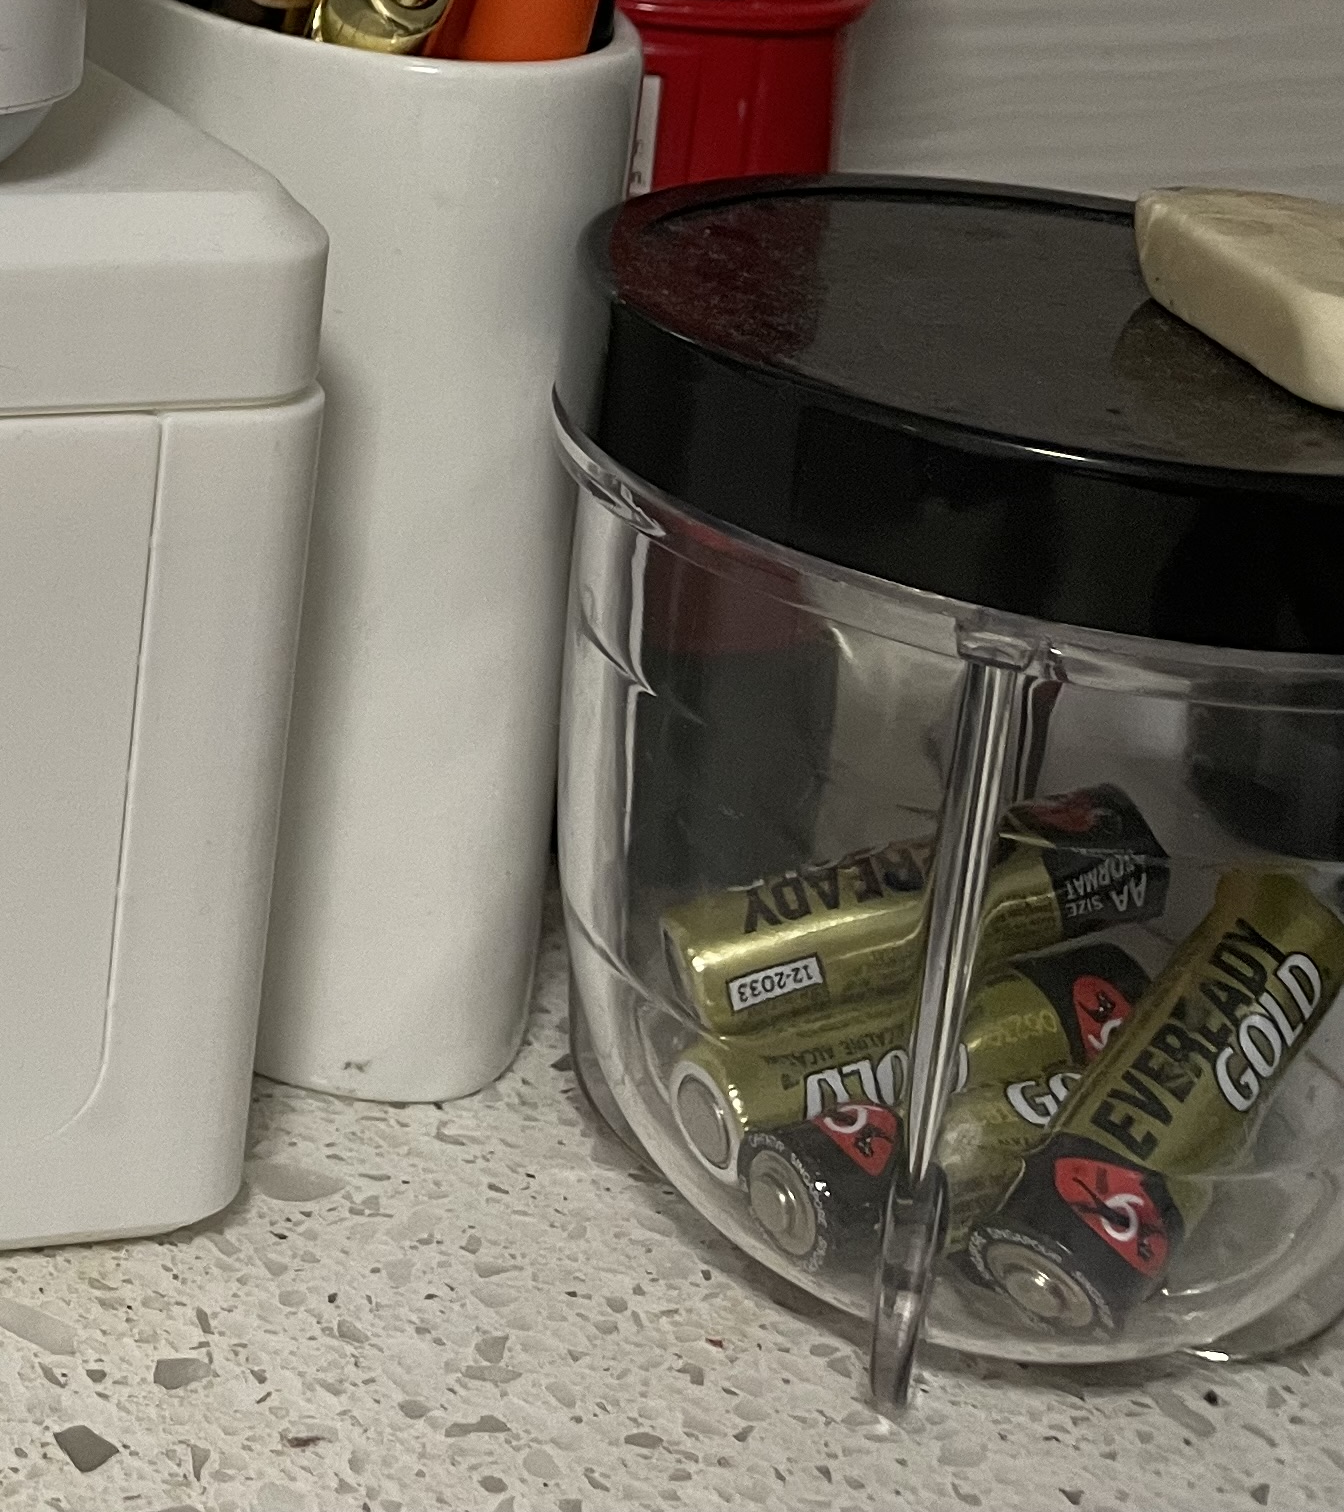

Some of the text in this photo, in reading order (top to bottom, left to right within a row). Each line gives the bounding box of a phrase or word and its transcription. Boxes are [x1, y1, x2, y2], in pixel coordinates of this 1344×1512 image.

[743, 846, 926, 935] READY
[1064, 871, 1148, 919] AA SIZE
[737, 963, 814, 1003] 12-2033
[1088, 916, 1288, 1163] EVEREADY
[1214, 949, 1324, 1113] GOLD
